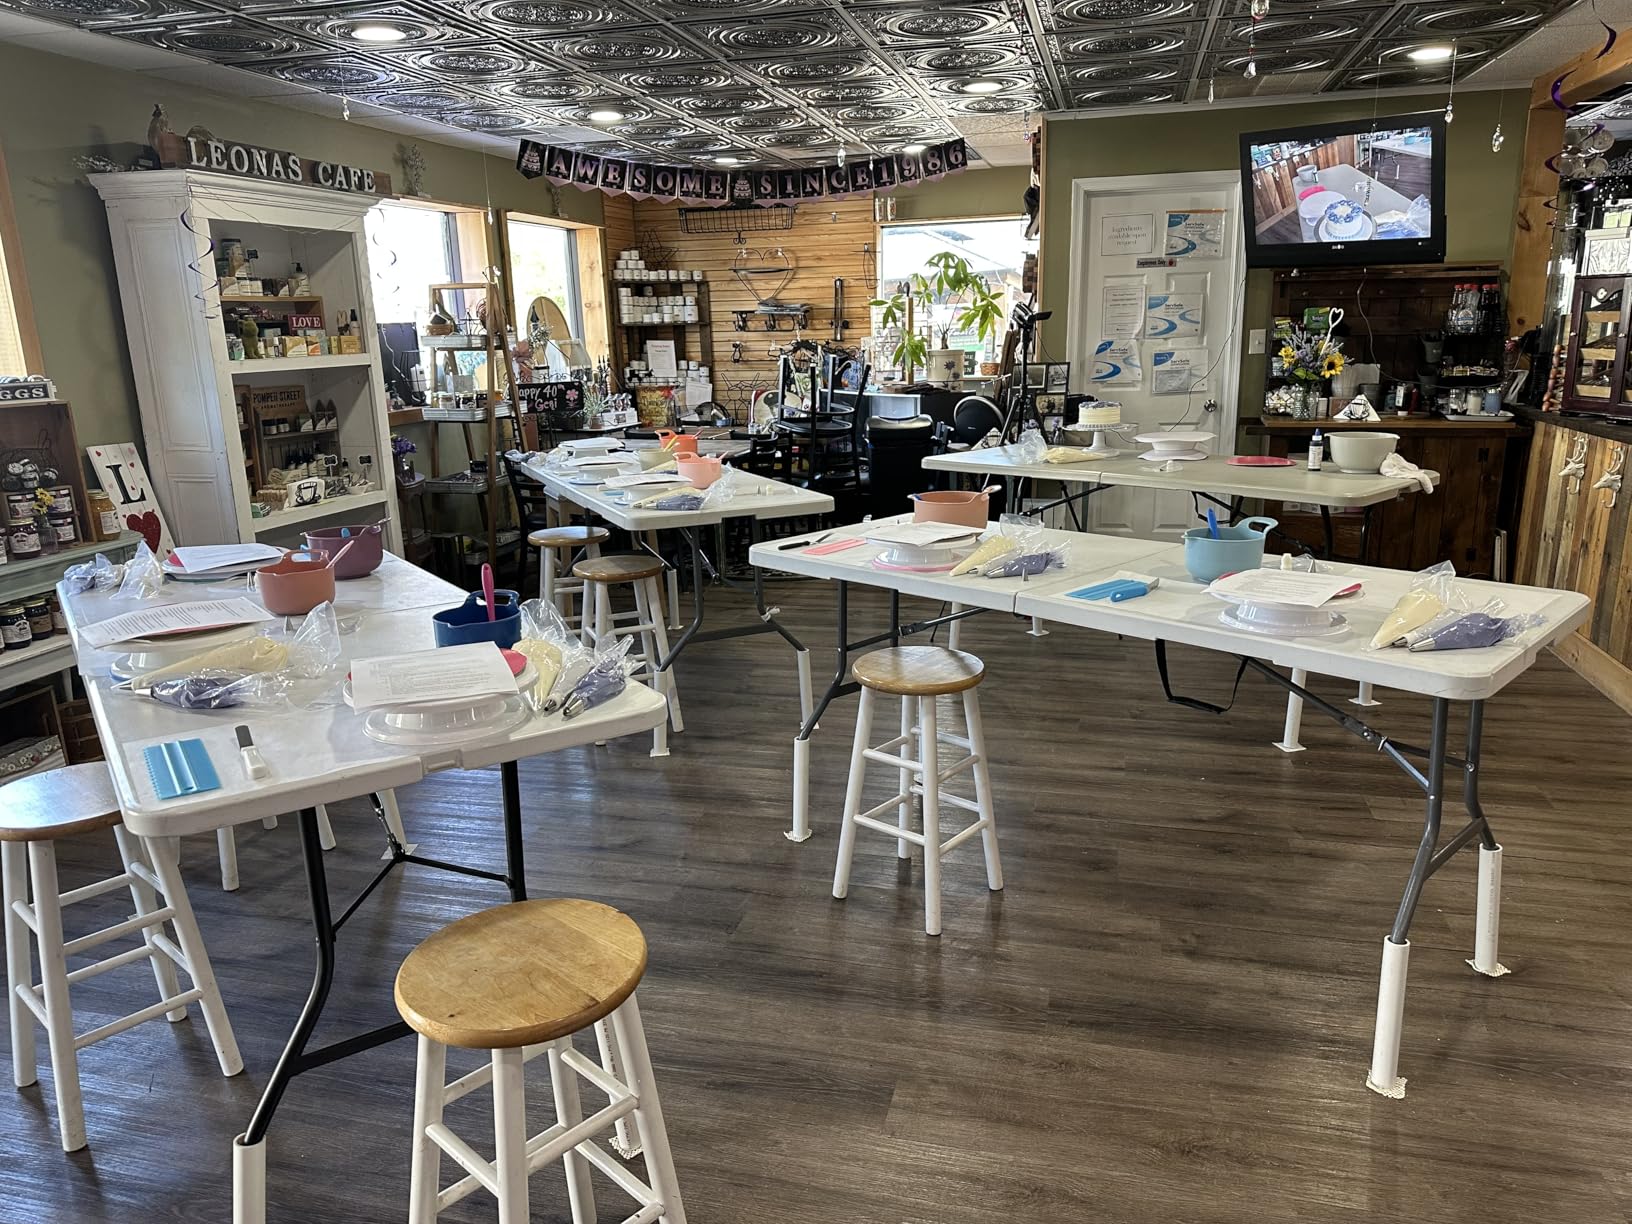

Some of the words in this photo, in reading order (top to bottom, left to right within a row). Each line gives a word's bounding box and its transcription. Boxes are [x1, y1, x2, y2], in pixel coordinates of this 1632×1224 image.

[187, 137, 303, 182] LEONAS
[318, 161, 377, 193] CAFE
[550, 155, 723, 195] AWESOME
[760, 162, 870, 194] SINCE
[879, 143, 964, 183] 1986
[291, 316, 321, 328] LOVE
[0, 387, 45, 400] GGS
[279, 390, 301, 402] STREET
[518, 387, 541, 400] appy
[105, 463, 147, 505] L
